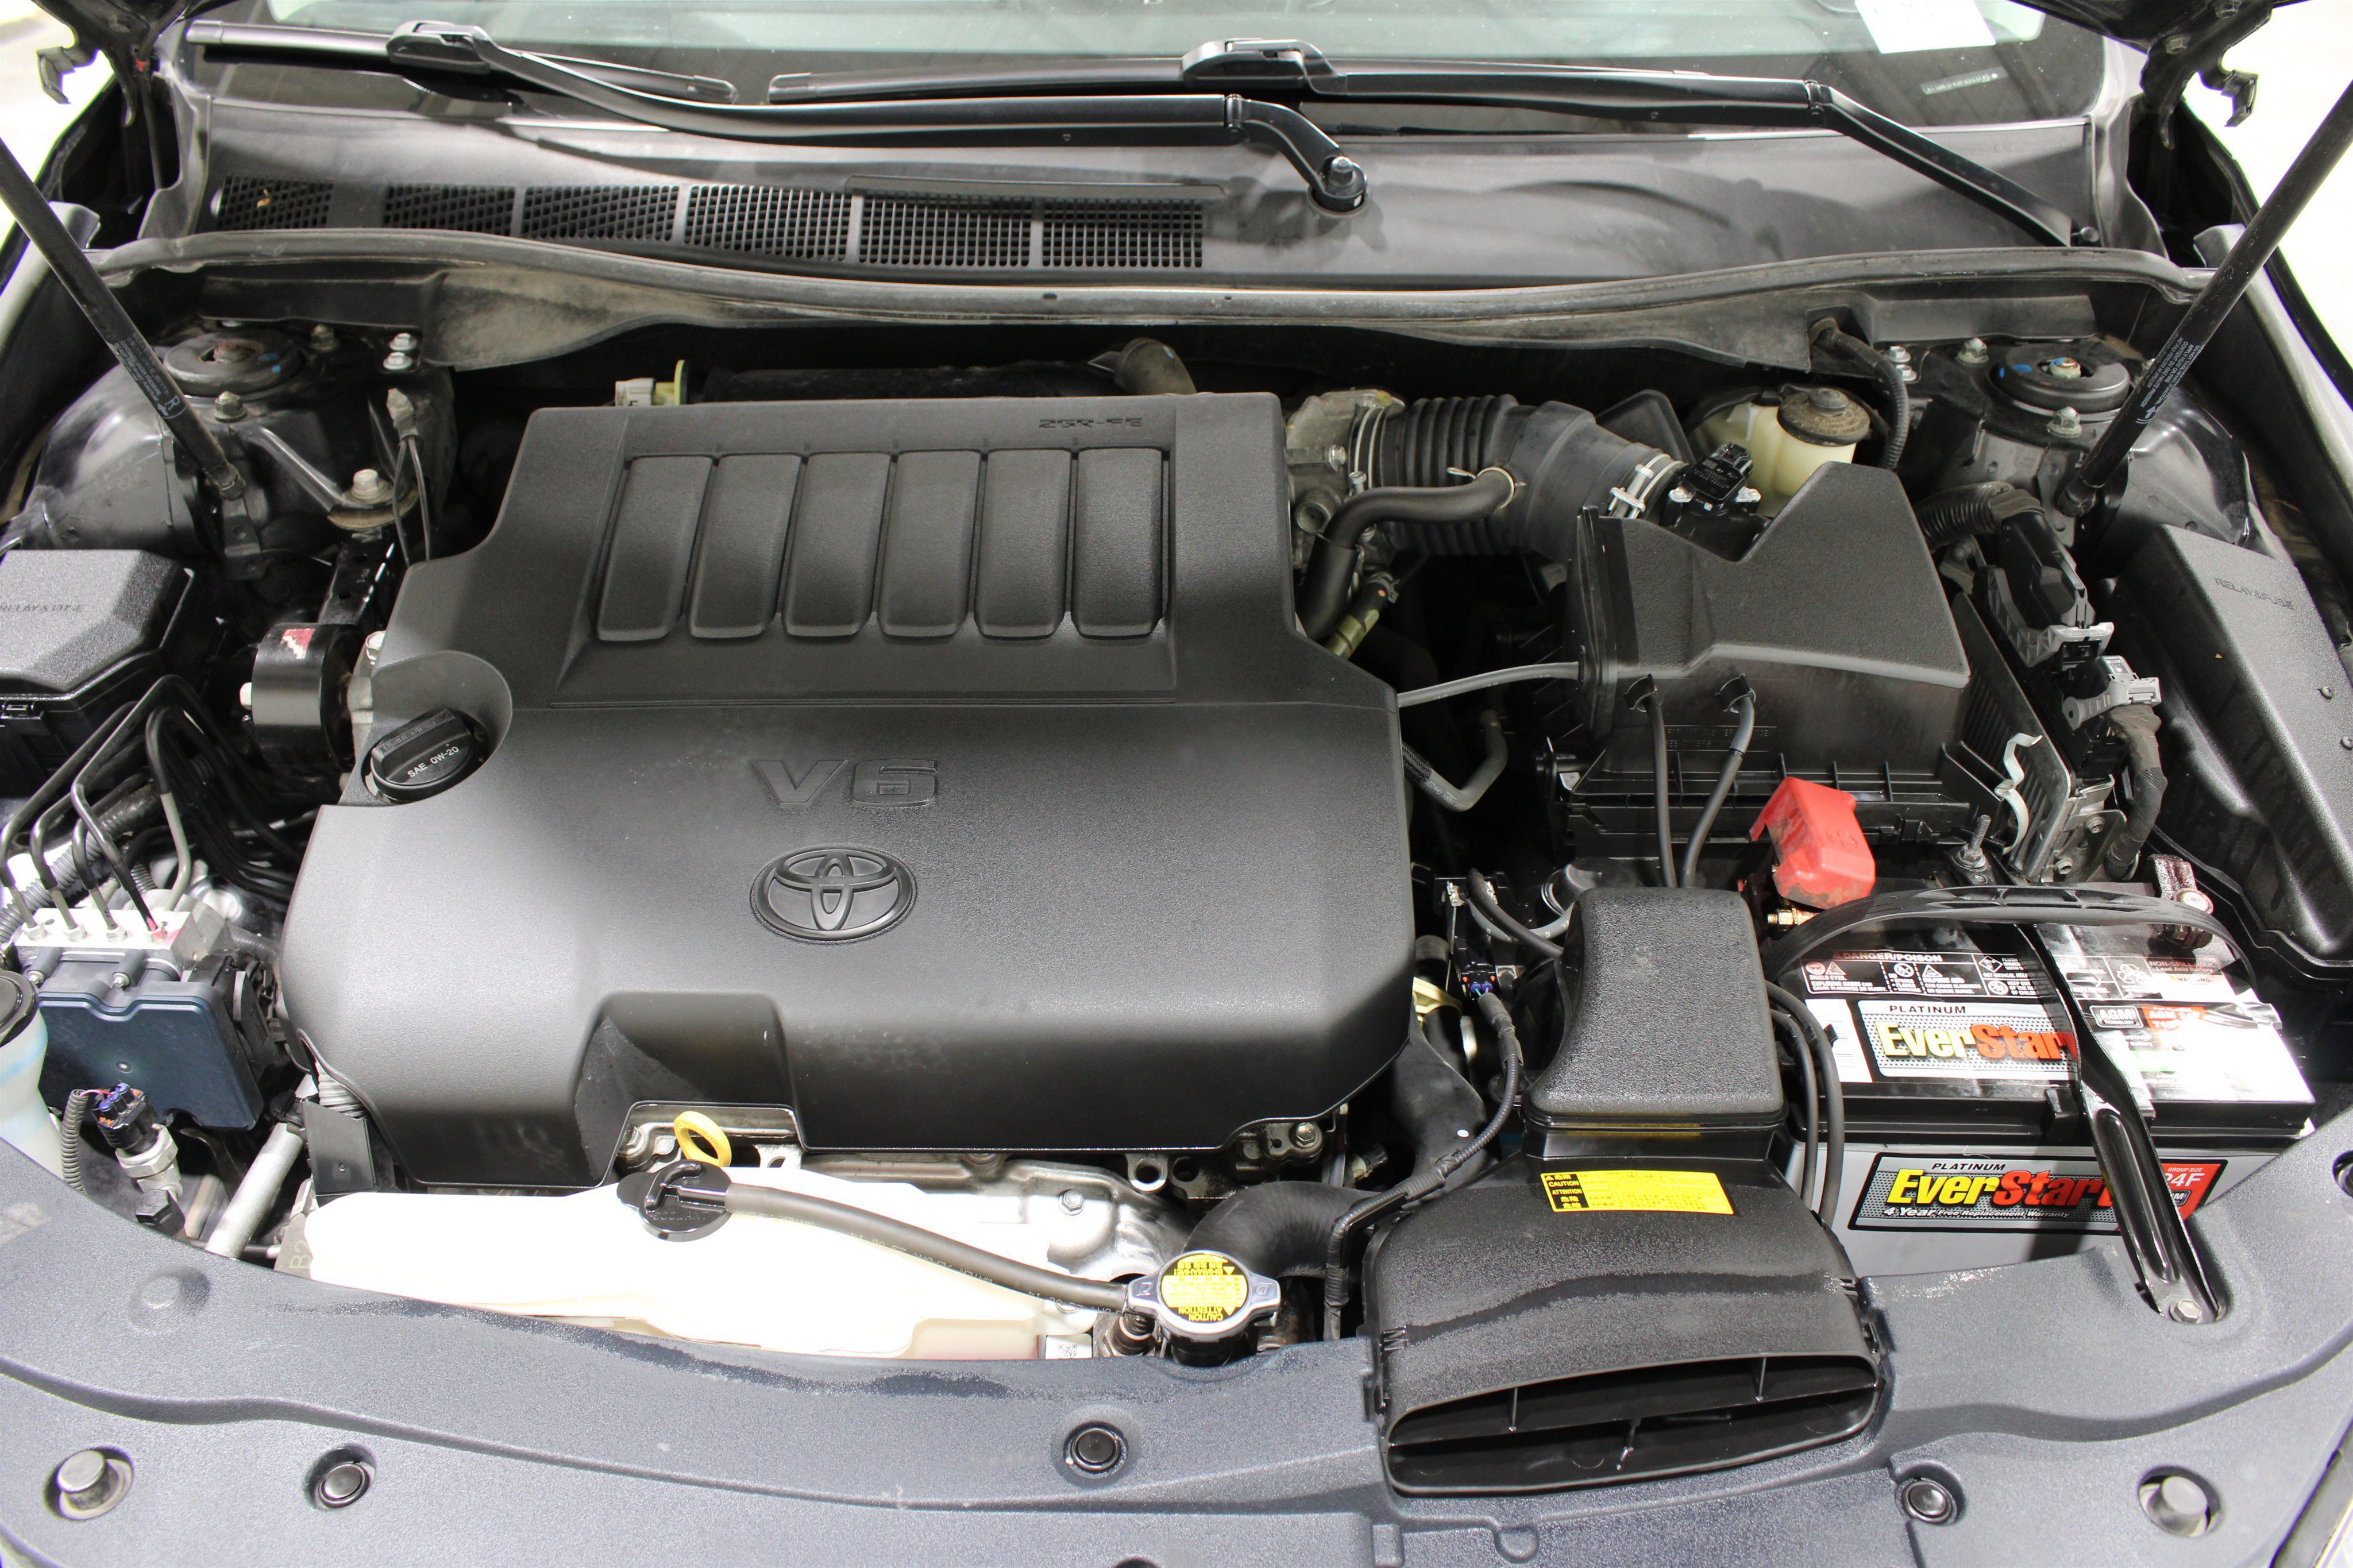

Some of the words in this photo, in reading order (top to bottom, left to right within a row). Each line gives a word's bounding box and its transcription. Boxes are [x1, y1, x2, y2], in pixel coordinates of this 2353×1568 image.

[2170, 342, 2179, 352] PAS
[2172, 341, 2188, 361] CONTIENT
[2182, 343, 2193, 357] APPLY
[2159, 351, 2173, 369] PERCER
[2162, 366, 2170, 376] GAZ
[2170, 366, 2177, 374] OR
[2153, 374, 2165, 388] HAUTE
[2164, 373, 2173, 383] FIRE
[164, 395, 180, 410] R
[2139, 387, 2156, 408] PRESSION
[407, 762, 427, 778] SAE
[430, 746, 460, 764] 0W-20
[755, 759, 938, 806] V6
[1843, 952, 1943, 962] DANGER/POISON
[1890, 1005, 1966, 1014] PLATINUM
[2099, 1009, 2134, 1020] AGM
[2150, 1010, 2176, 1019] AGM
[1931, 1163, 2006, 1171] PLATINUM
[653, 1211, 708, 1221] COOLANT
[1883, 1207, 1895, 1216] 4
[1898, 1207, 1936, 1216] Year
[1961, 1209, 2025, 1217] Replacement
[2026, 1210, 2069, 1218] Warranty
